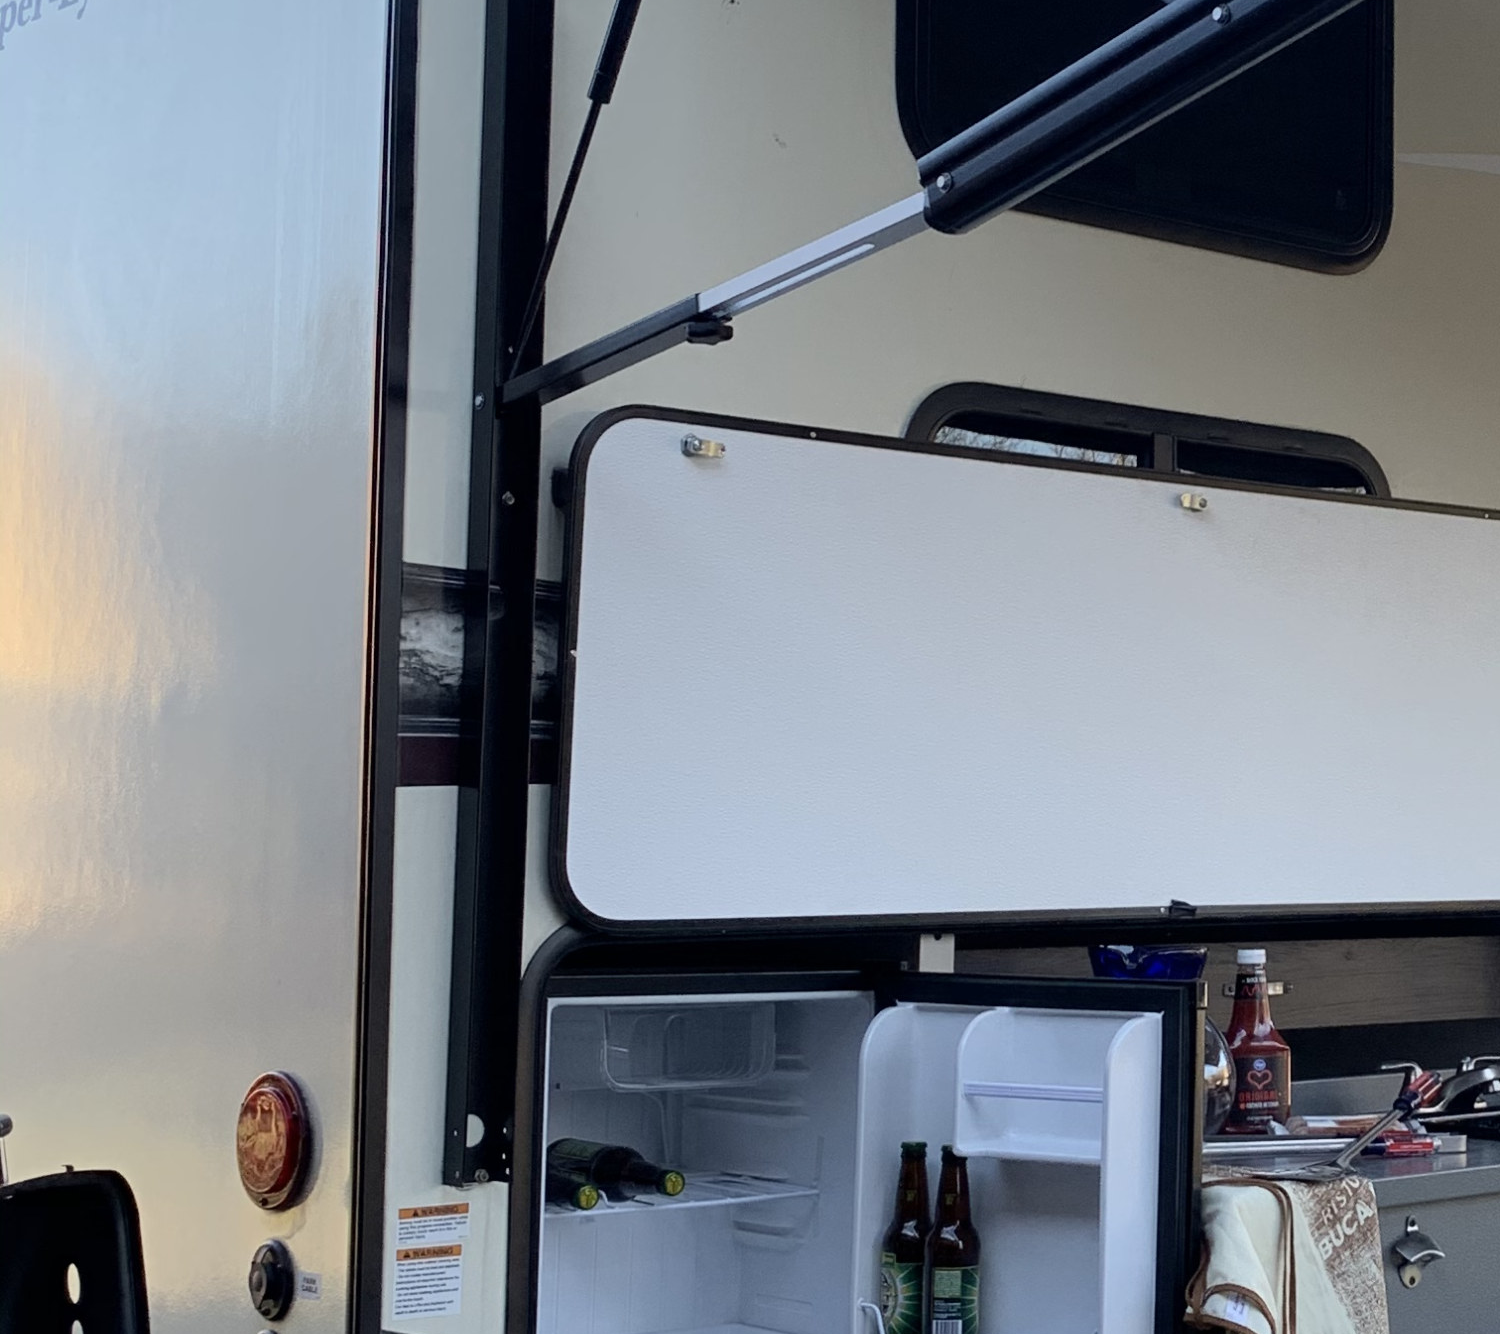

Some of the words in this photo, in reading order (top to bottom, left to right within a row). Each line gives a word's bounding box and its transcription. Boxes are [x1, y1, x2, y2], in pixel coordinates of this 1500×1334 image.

[420, 1205, 460, 1217] WARNING
[1318, 1199, 1374, 1261] BUCA
[412, 1246, 454, 1259] WARNING
